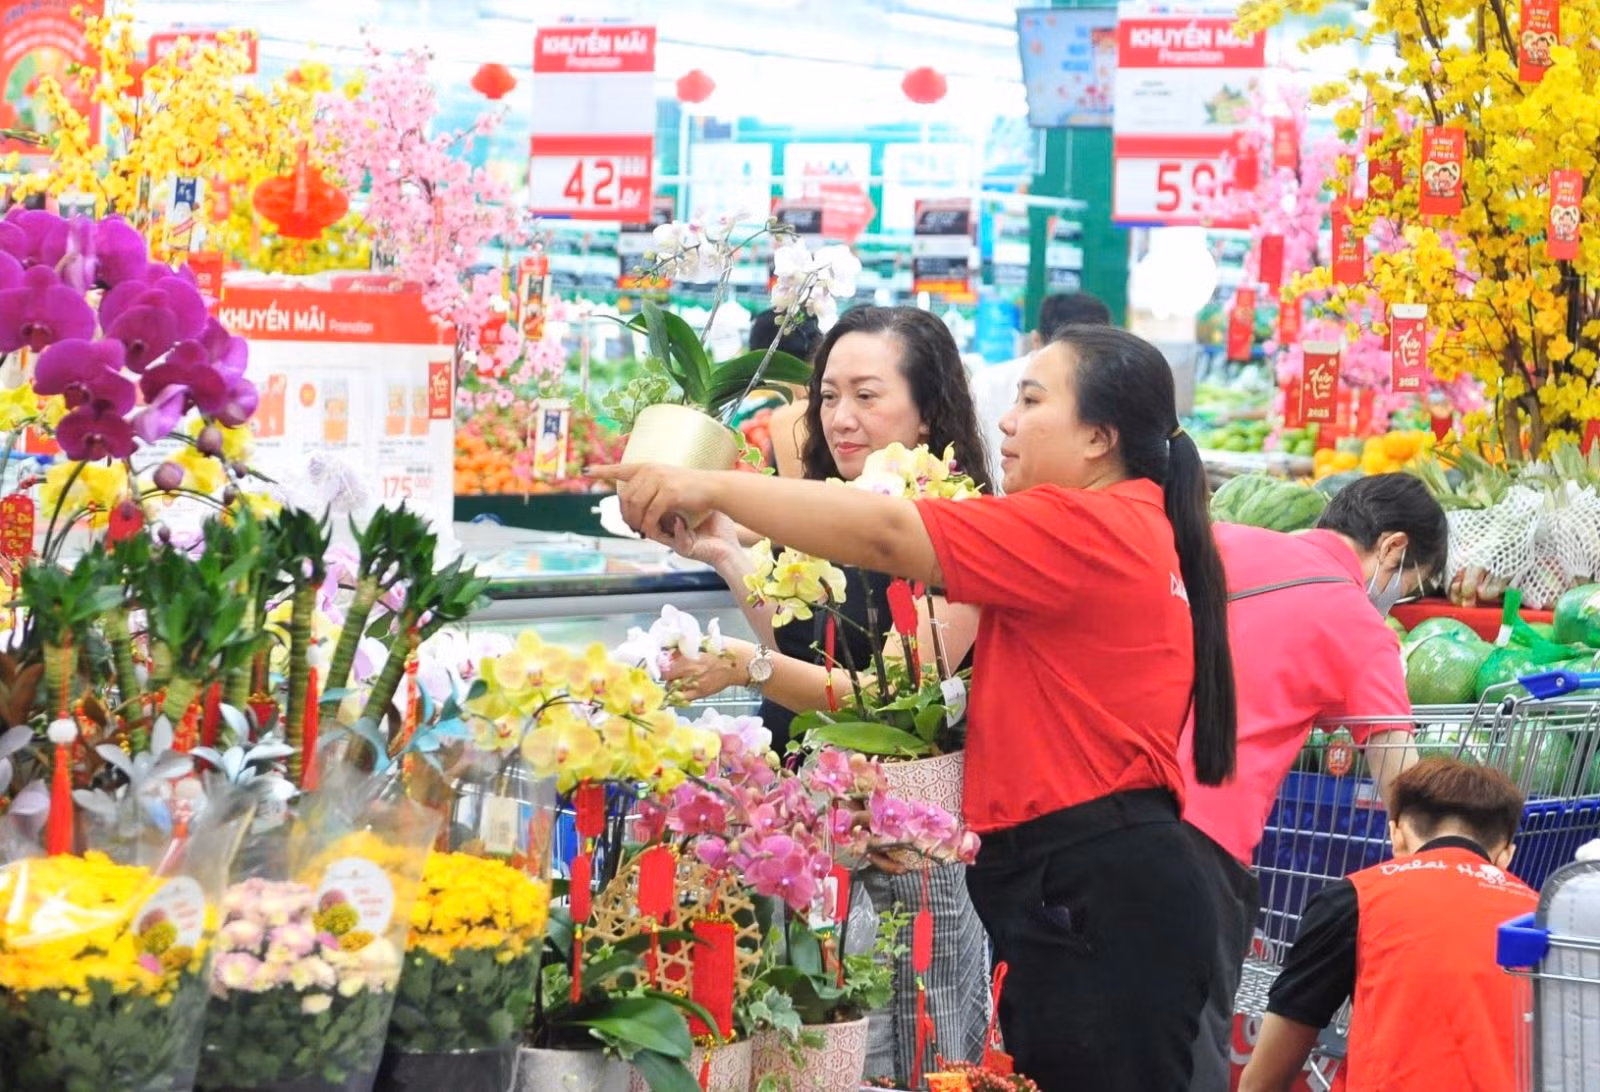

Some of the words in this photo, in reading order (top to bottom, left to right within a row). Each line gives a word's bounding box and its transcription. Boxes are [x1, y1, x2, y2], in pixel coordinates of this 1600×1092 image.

[563, 160, 612, 205] 42
[1307, 408, 1330, 418] 2025
[383, 476, 412, 499] 175
